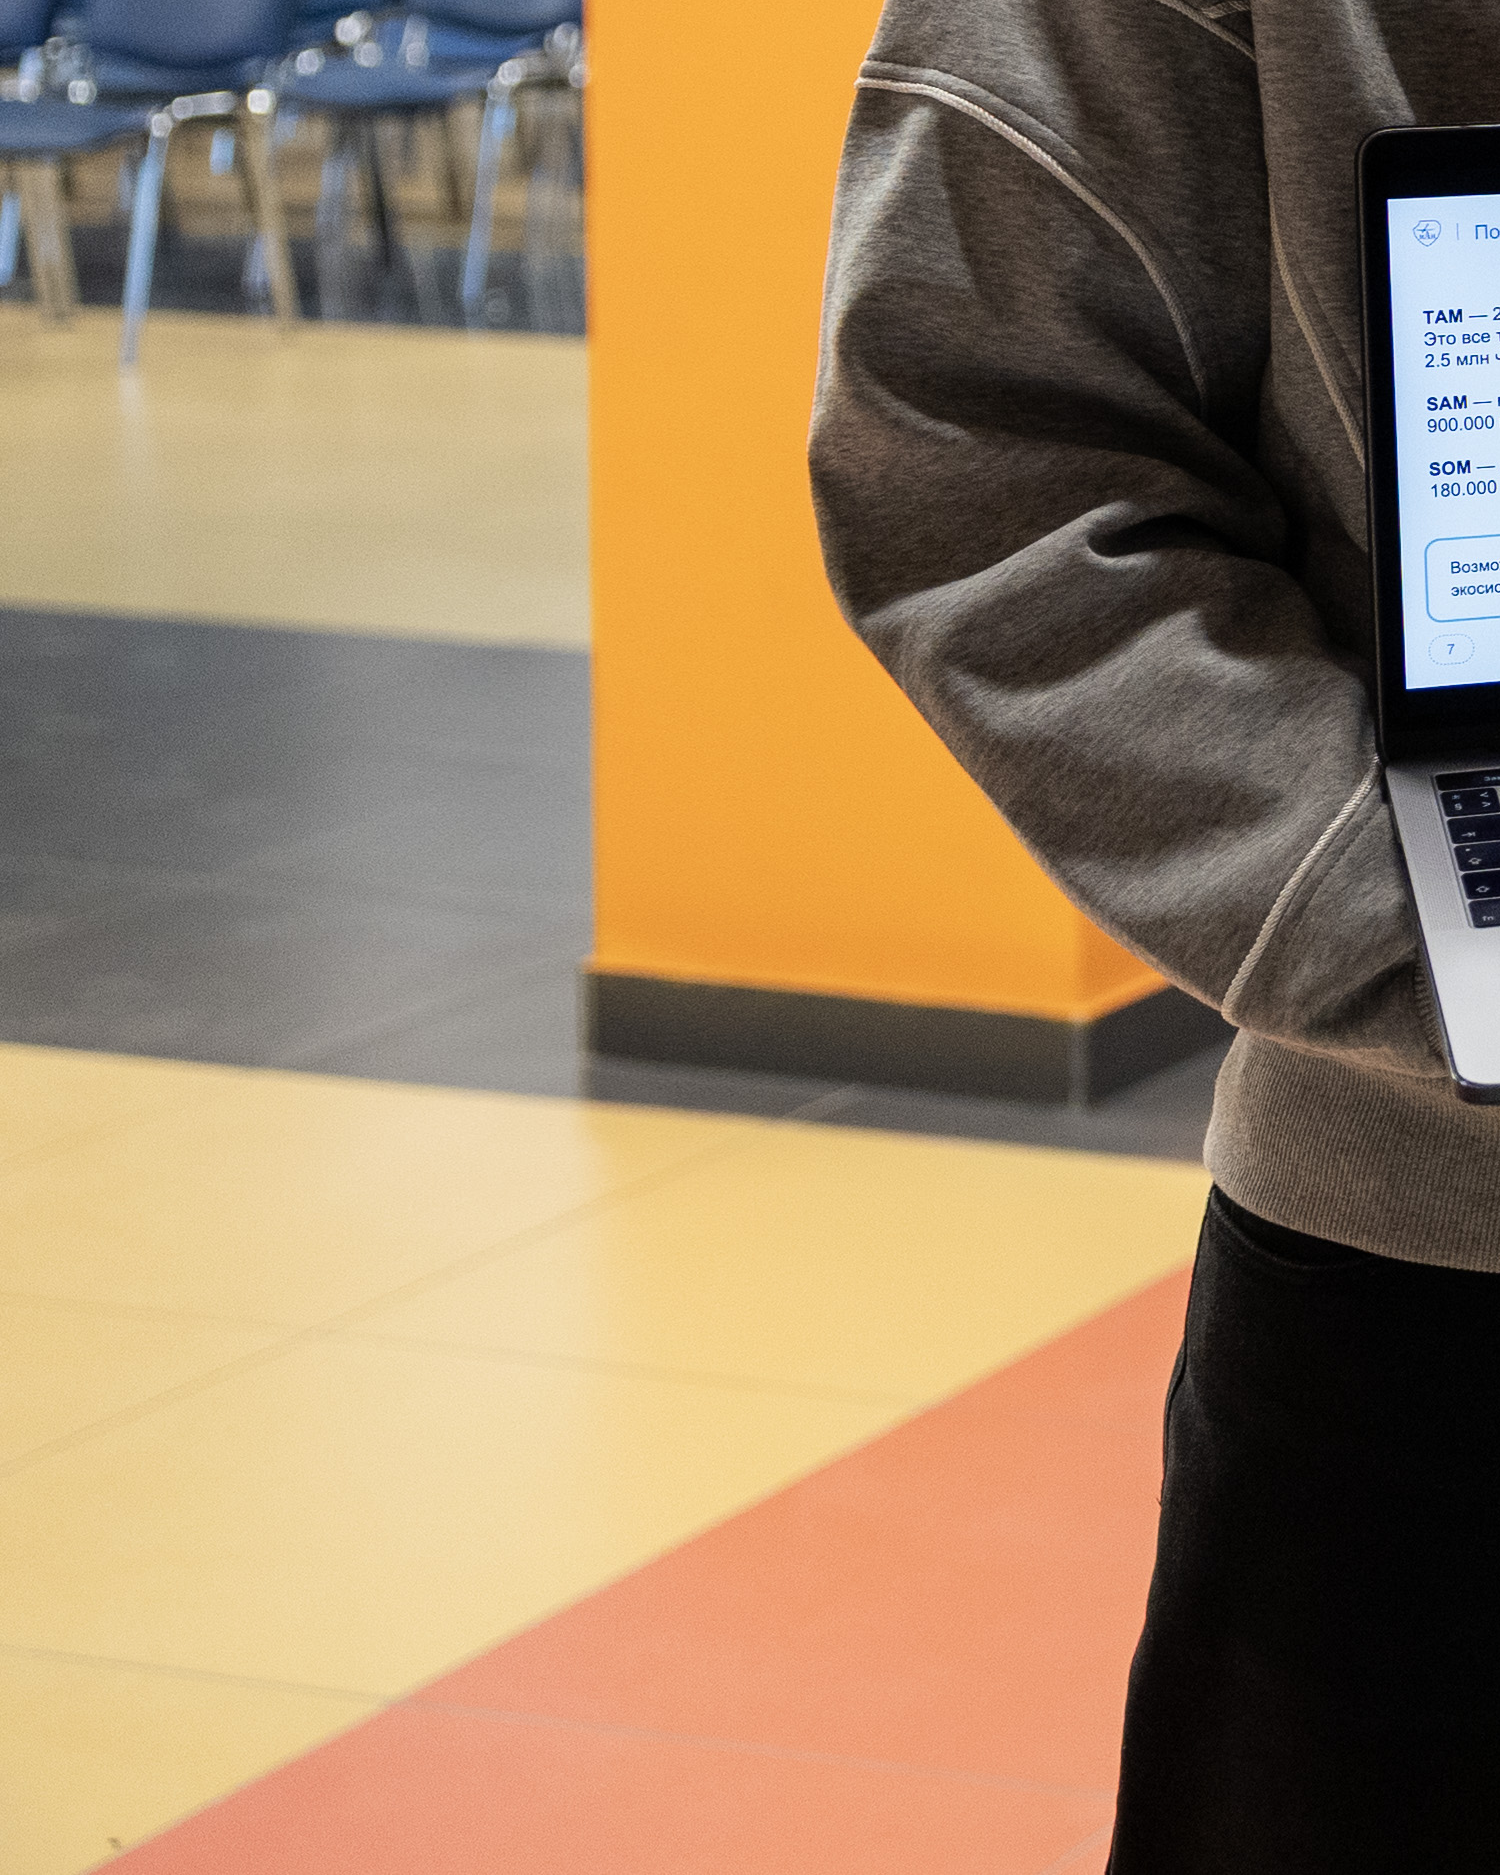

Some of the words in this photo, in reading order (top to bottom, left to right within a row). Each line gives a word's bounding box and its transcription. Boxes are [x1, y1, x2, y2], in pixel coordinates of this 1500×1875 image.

[1422, 308, 1463, 324] TAM
[1424, 331, 1456, 346] Это
[1462, 332, 1490, 344] все
[1425, 352, 1450, 368] 2.5
[1456, 354, 1489, 365] млн
[1426, 394, 1467, 411] SAM
[1427, 414, 1494, 433] 900.000
[1429, 459, 1471, 476] SOM
[1431, 479, 1497, 497] 180.000
[1447, 643, 1455, 654] 7
